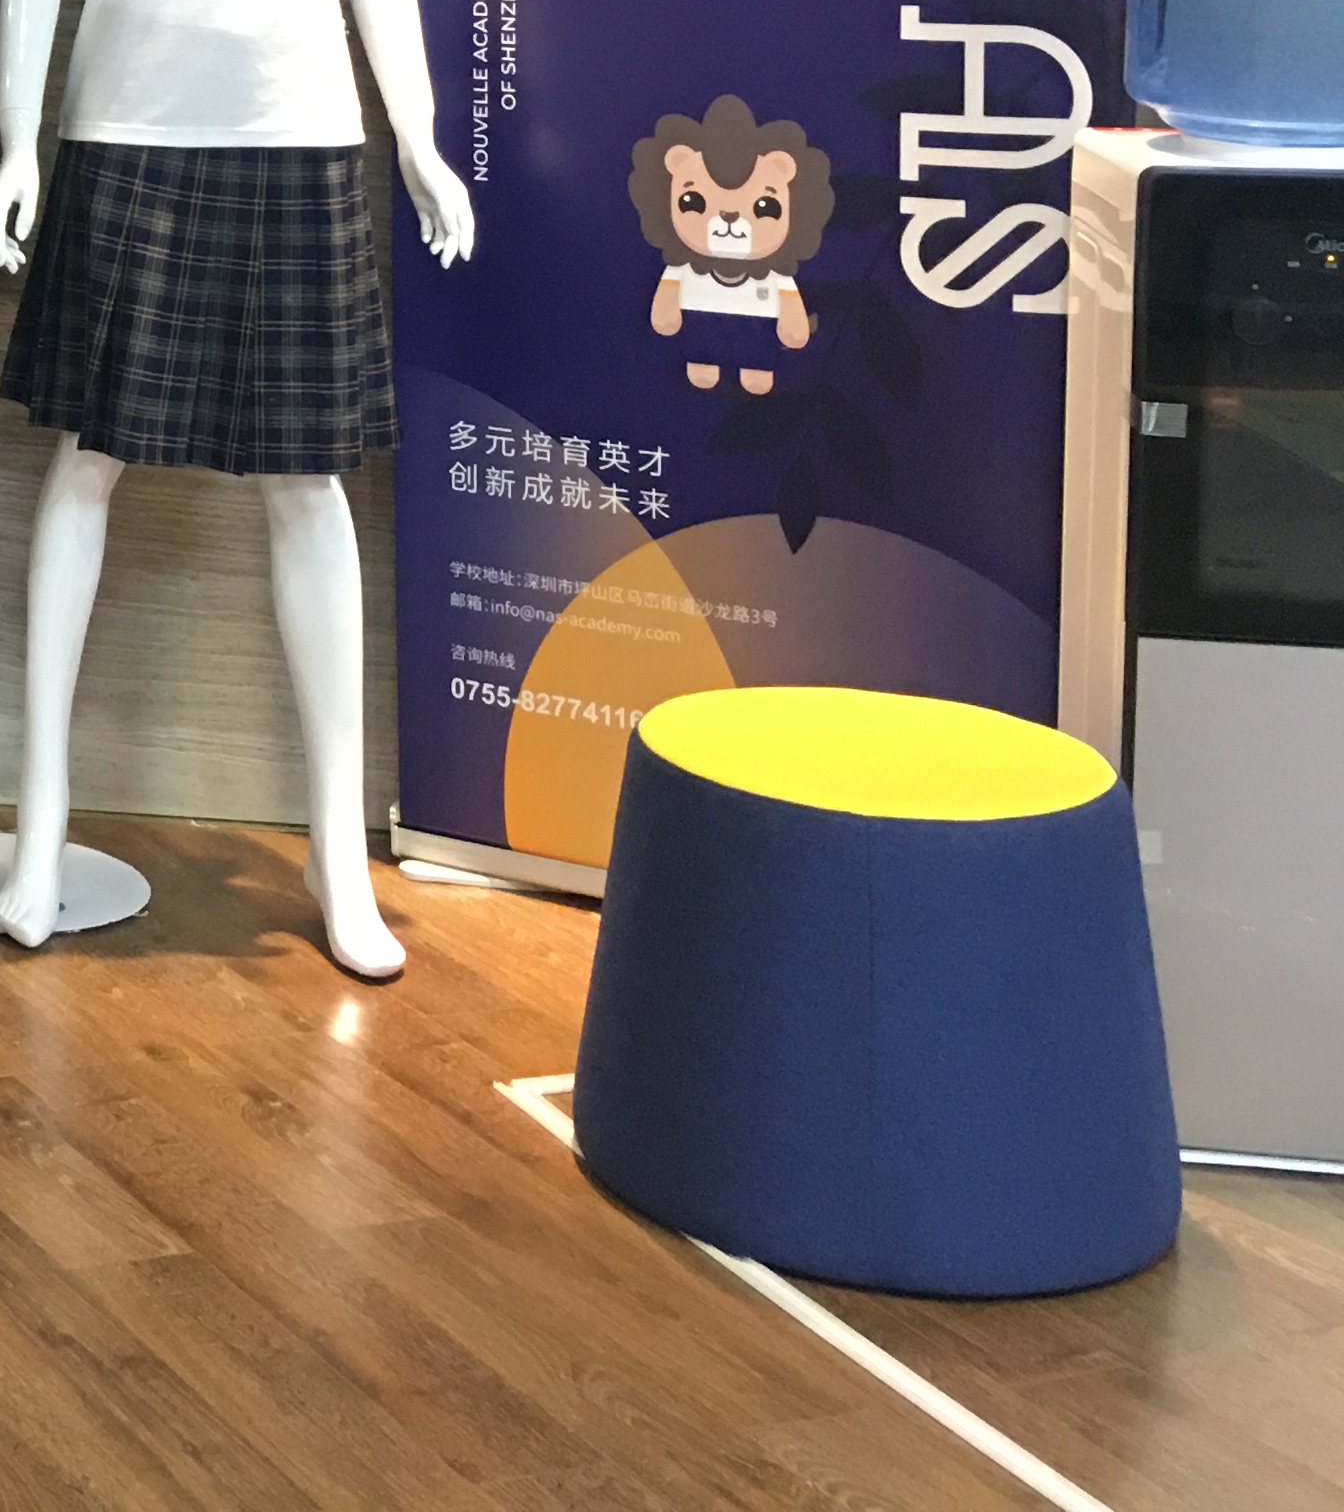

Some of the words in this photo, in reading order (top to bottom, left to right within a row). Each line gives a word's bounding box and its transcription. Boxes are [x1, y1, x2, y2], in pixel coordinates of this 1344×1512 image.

[500, 80, 517, 111] OF
[472, 68, 489, 182] NOUVELLE
[448, 420, 671, 478] 多元培育英才
[448, 461, 671, 519] 创新成就未来
[450, 643, 516, 671] 咨询热线
